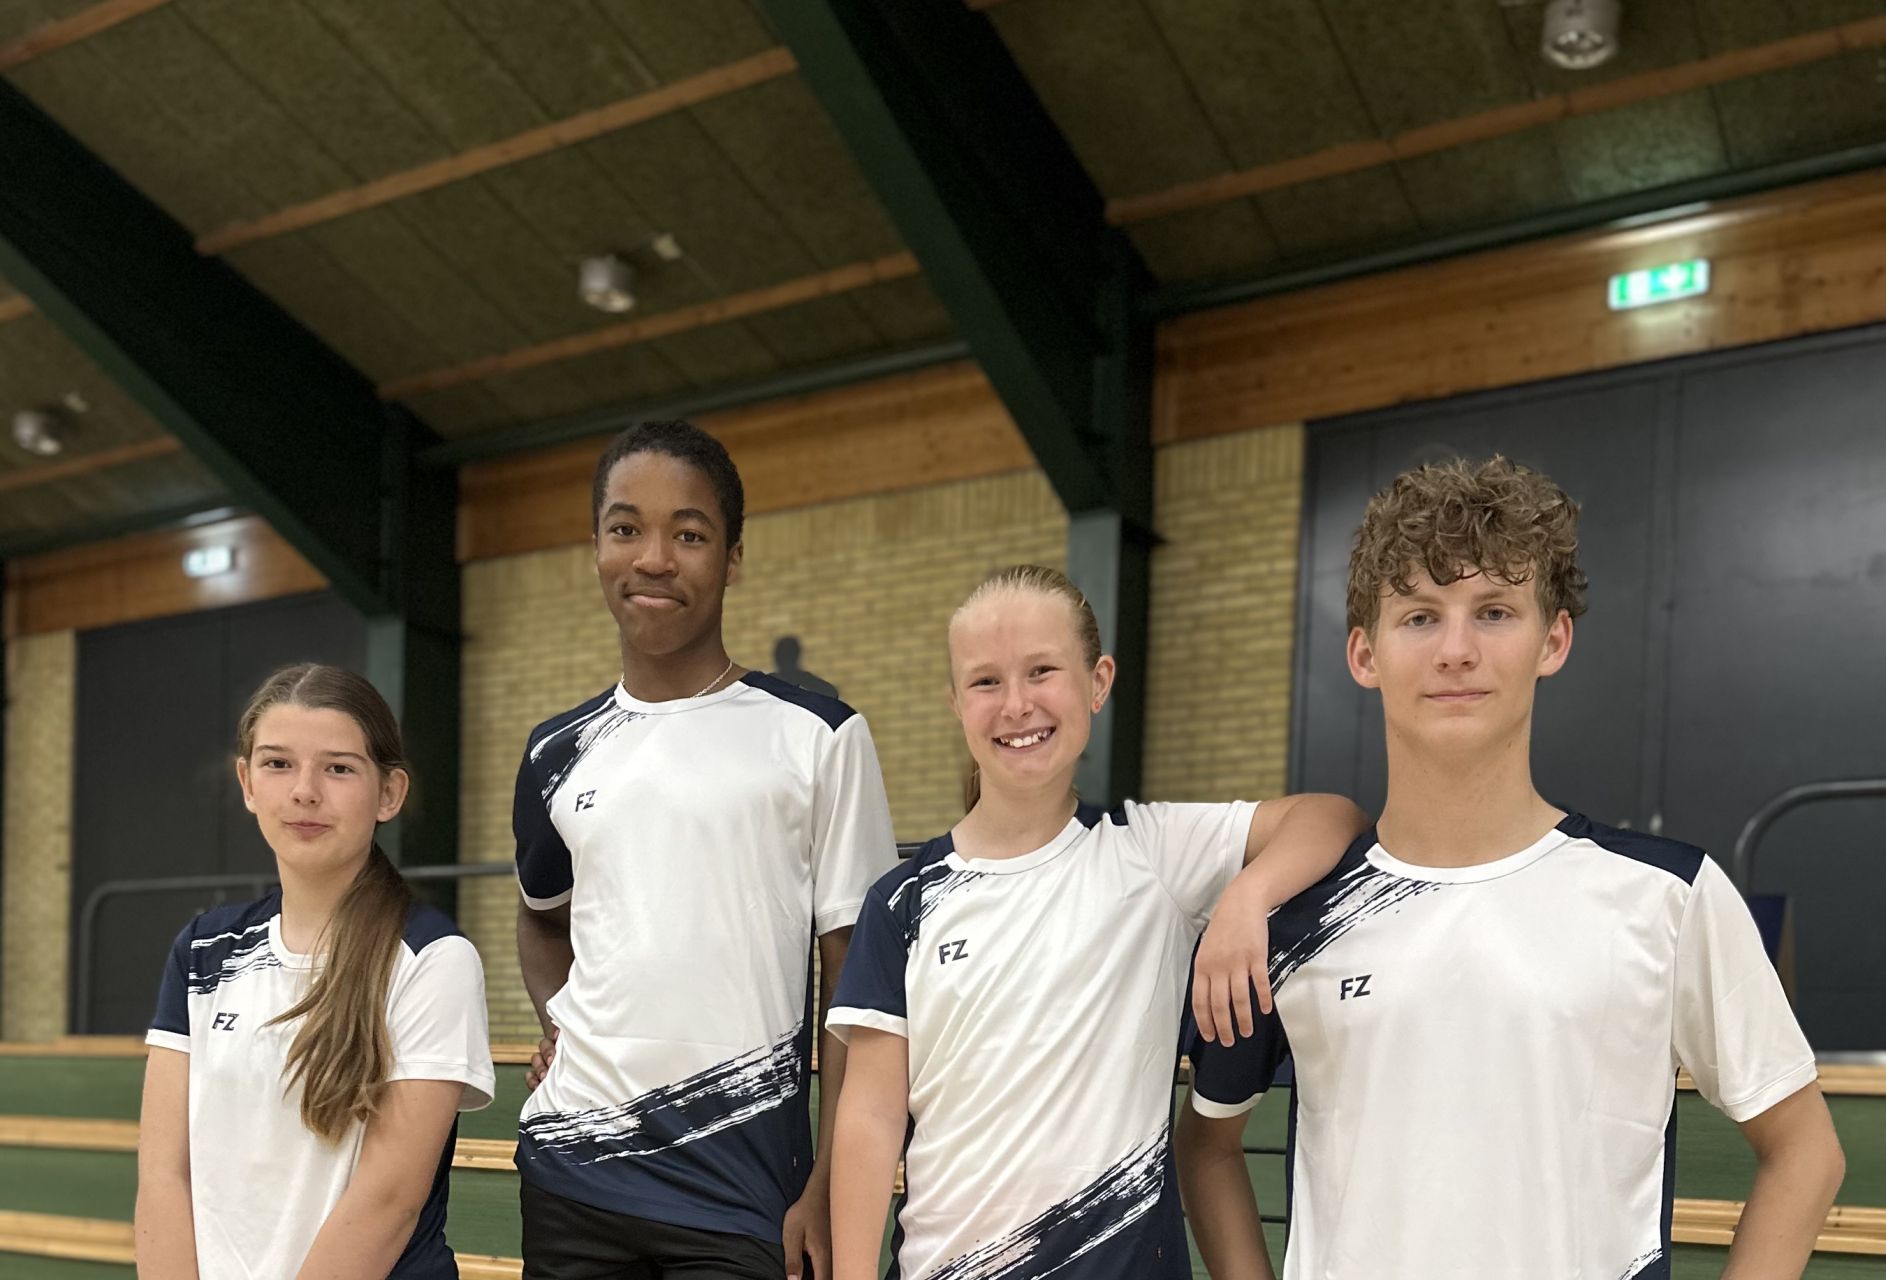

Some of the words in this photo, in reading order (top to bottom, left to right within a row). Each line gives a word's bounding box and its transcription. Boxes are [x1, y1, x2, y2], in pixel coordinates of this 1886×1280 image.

[575, 789, 597, 812] FZ
[939, 939, 969, 965] FZ
[1340, 974, 1372, 1001] FZ
[211, 1012, 240, 1031] FZ
